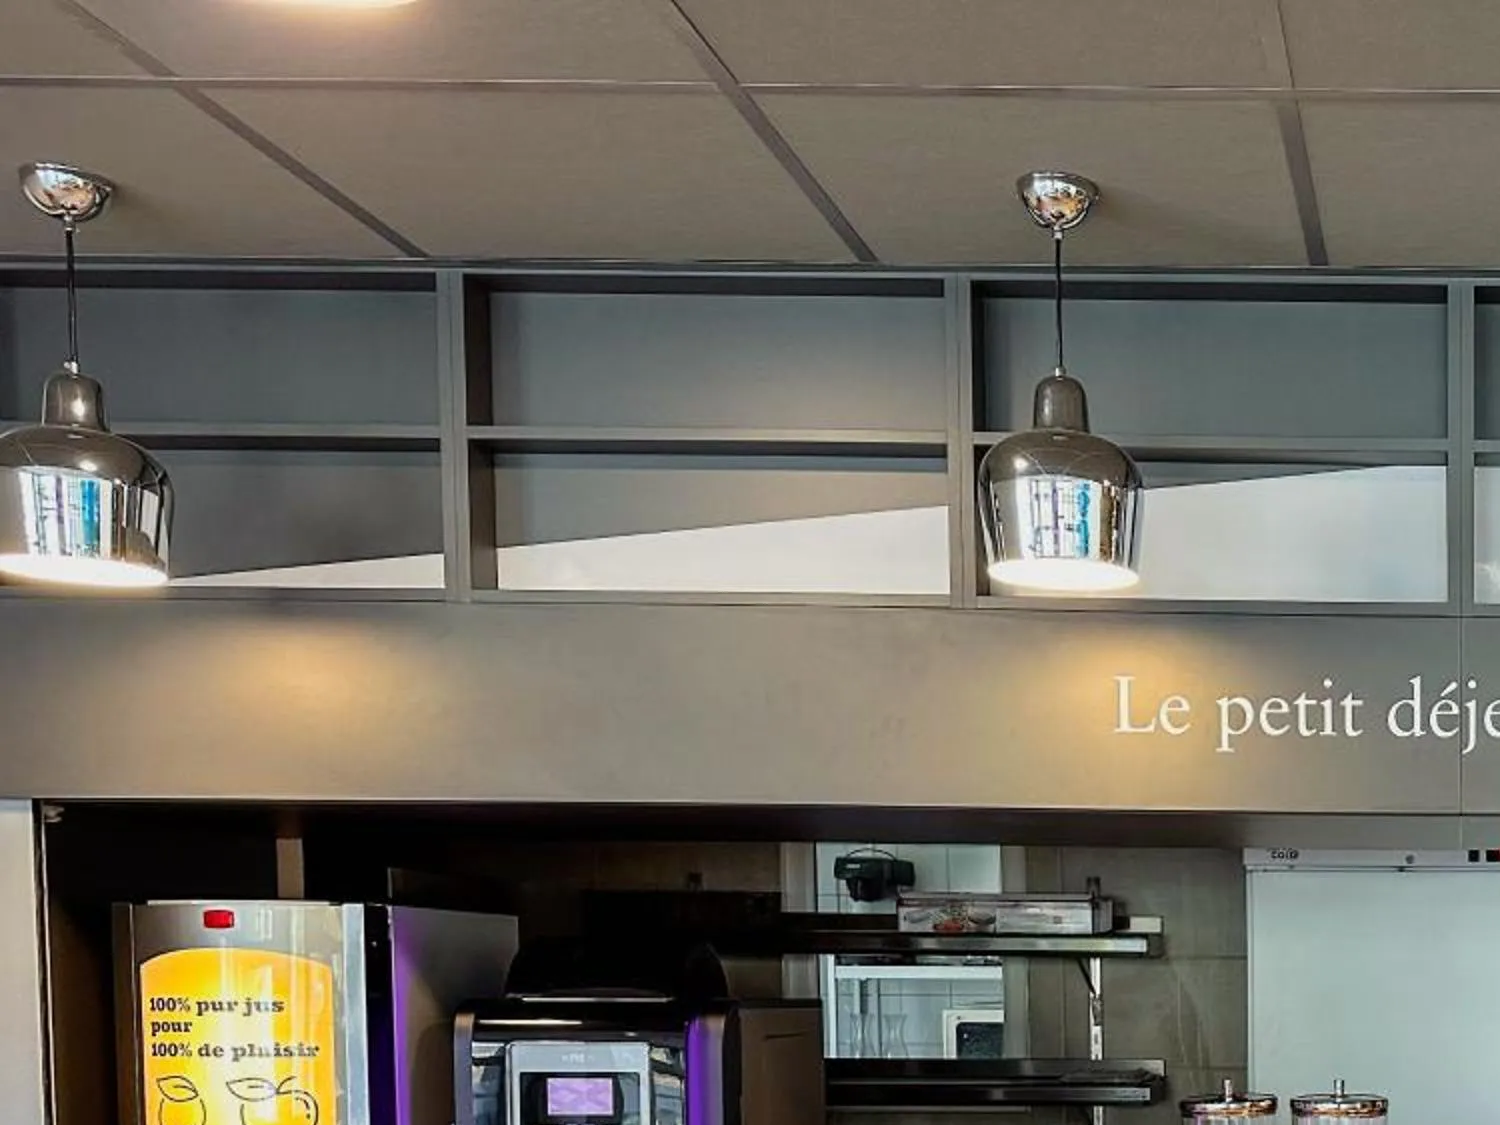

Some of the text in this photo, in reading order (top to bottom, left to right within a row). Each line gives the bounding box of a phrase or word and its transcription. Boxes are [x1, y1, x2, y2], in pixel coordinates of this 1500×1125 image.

[1113, 674, 1191, 735] Le
[1215, 677, 1365, 753] petit
[149, 997, 285, 1017] 100% pur jus
[151, 1020, 193, 1037] pour
[151, 1043, 193, 1057] 100%
[197, 1043, 225, 1057] de
